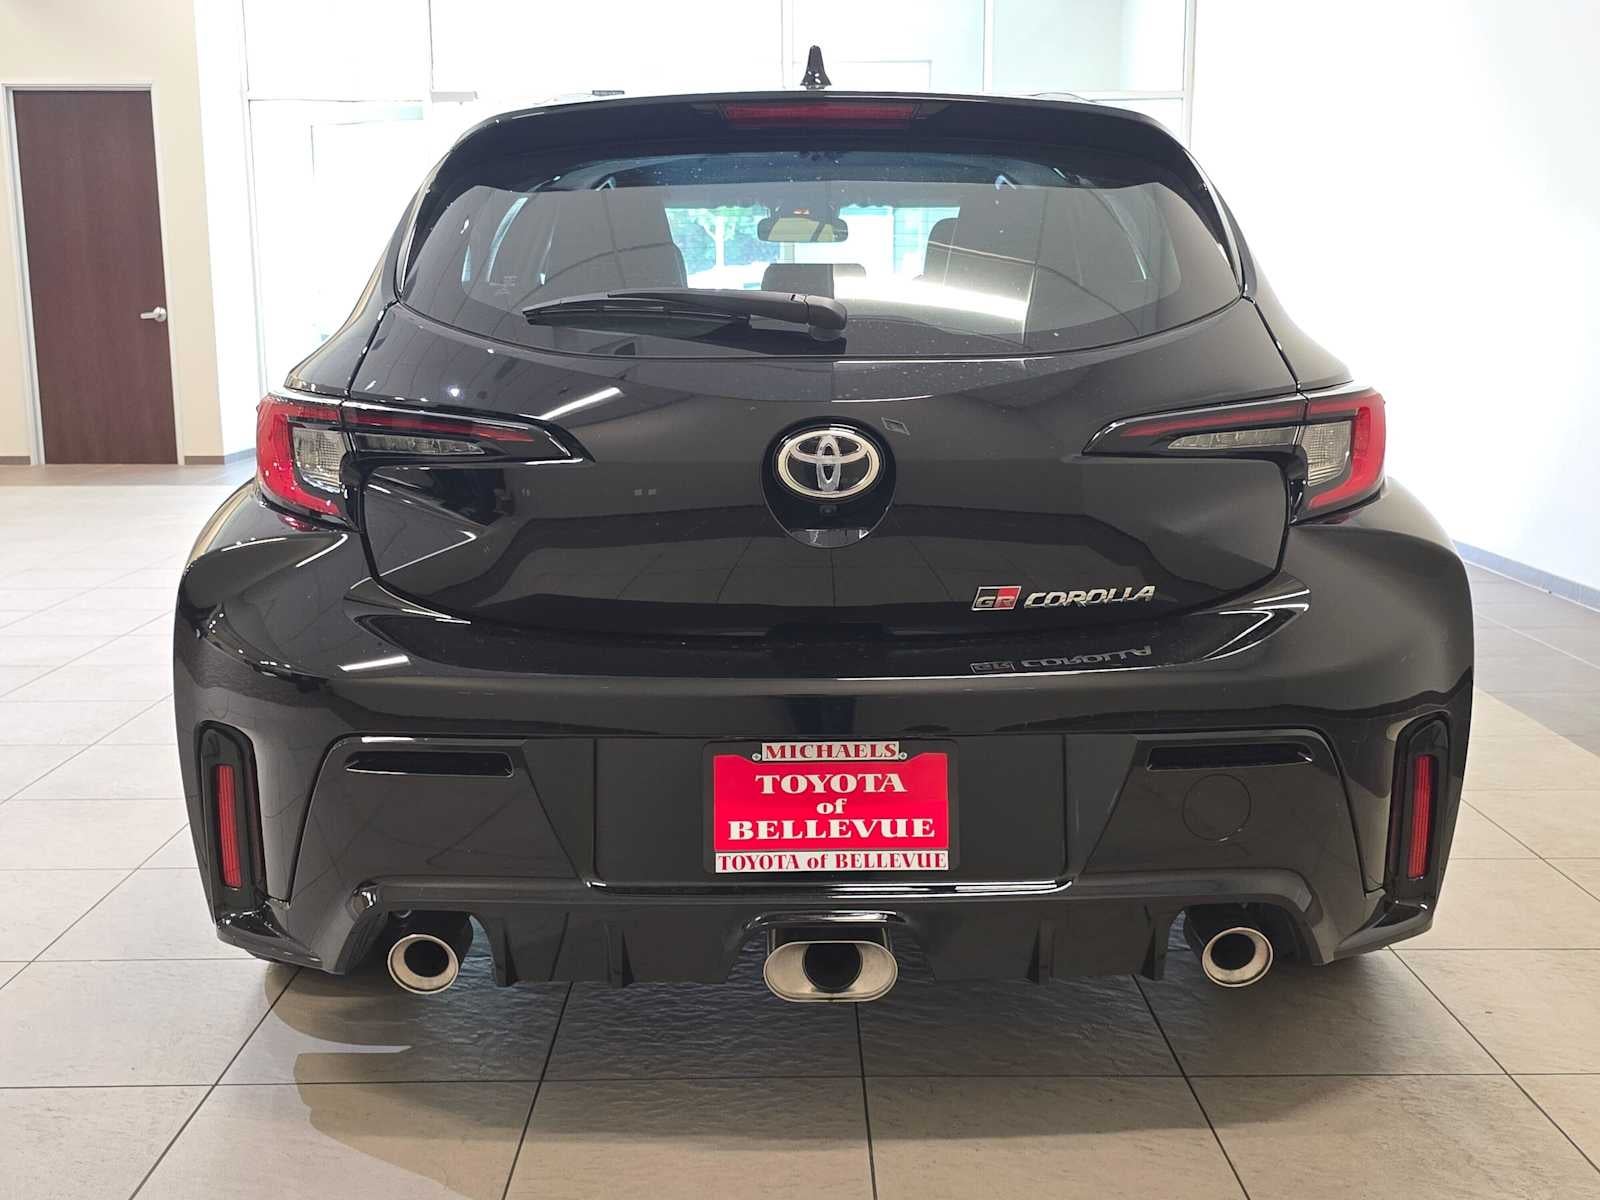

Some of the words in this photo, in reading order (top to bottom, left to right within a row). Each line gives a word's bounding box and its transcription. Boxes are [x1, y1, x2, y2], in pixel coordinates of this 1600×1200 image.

[975, 594, 1015, 608] GR
[1024, 585, 1156, 608] COROLLA
[766, 743, 896, 759] MICHAELS
[755, 773, 907, 794] TOYOTA
[816, 798, 848, 815] of
[728, 818, 935, 840] BELLEVUE
[719, 854, 799, 870] TOYOTA
[807, 853, 829, 869] of
[835, 852, 947, 868] BELLEVUE
